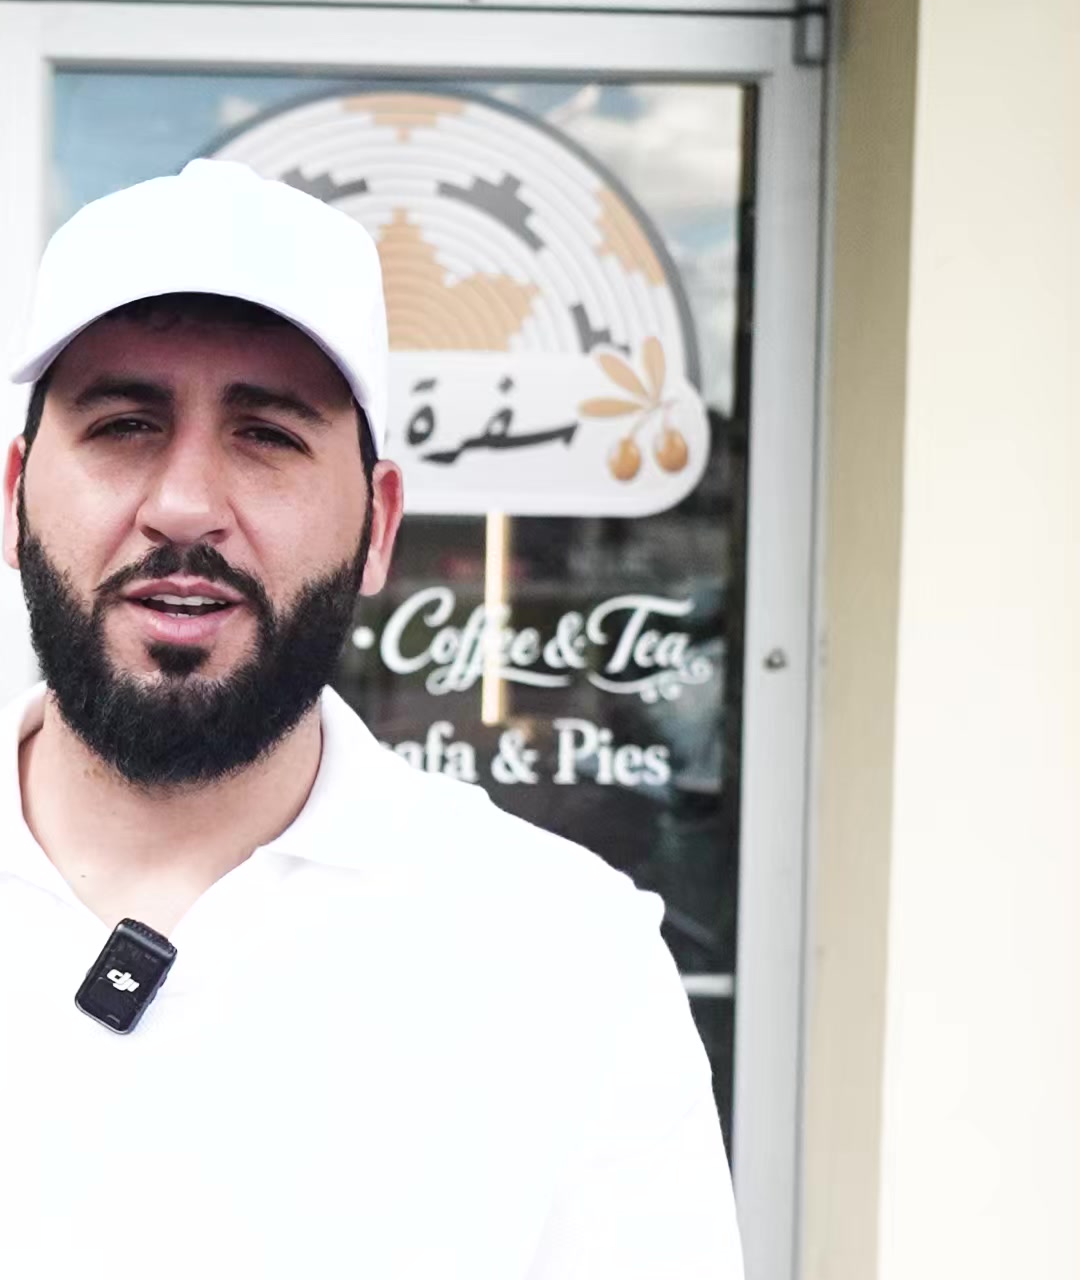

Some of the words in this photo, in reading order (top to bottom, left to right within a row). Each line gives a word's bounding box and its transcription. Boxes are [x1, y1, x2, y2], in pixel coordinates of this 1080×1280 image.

[406, 376, 580, 465] سفرة
[491, 728, 539, 784] &
[553, 717, 672, 786] Pies
